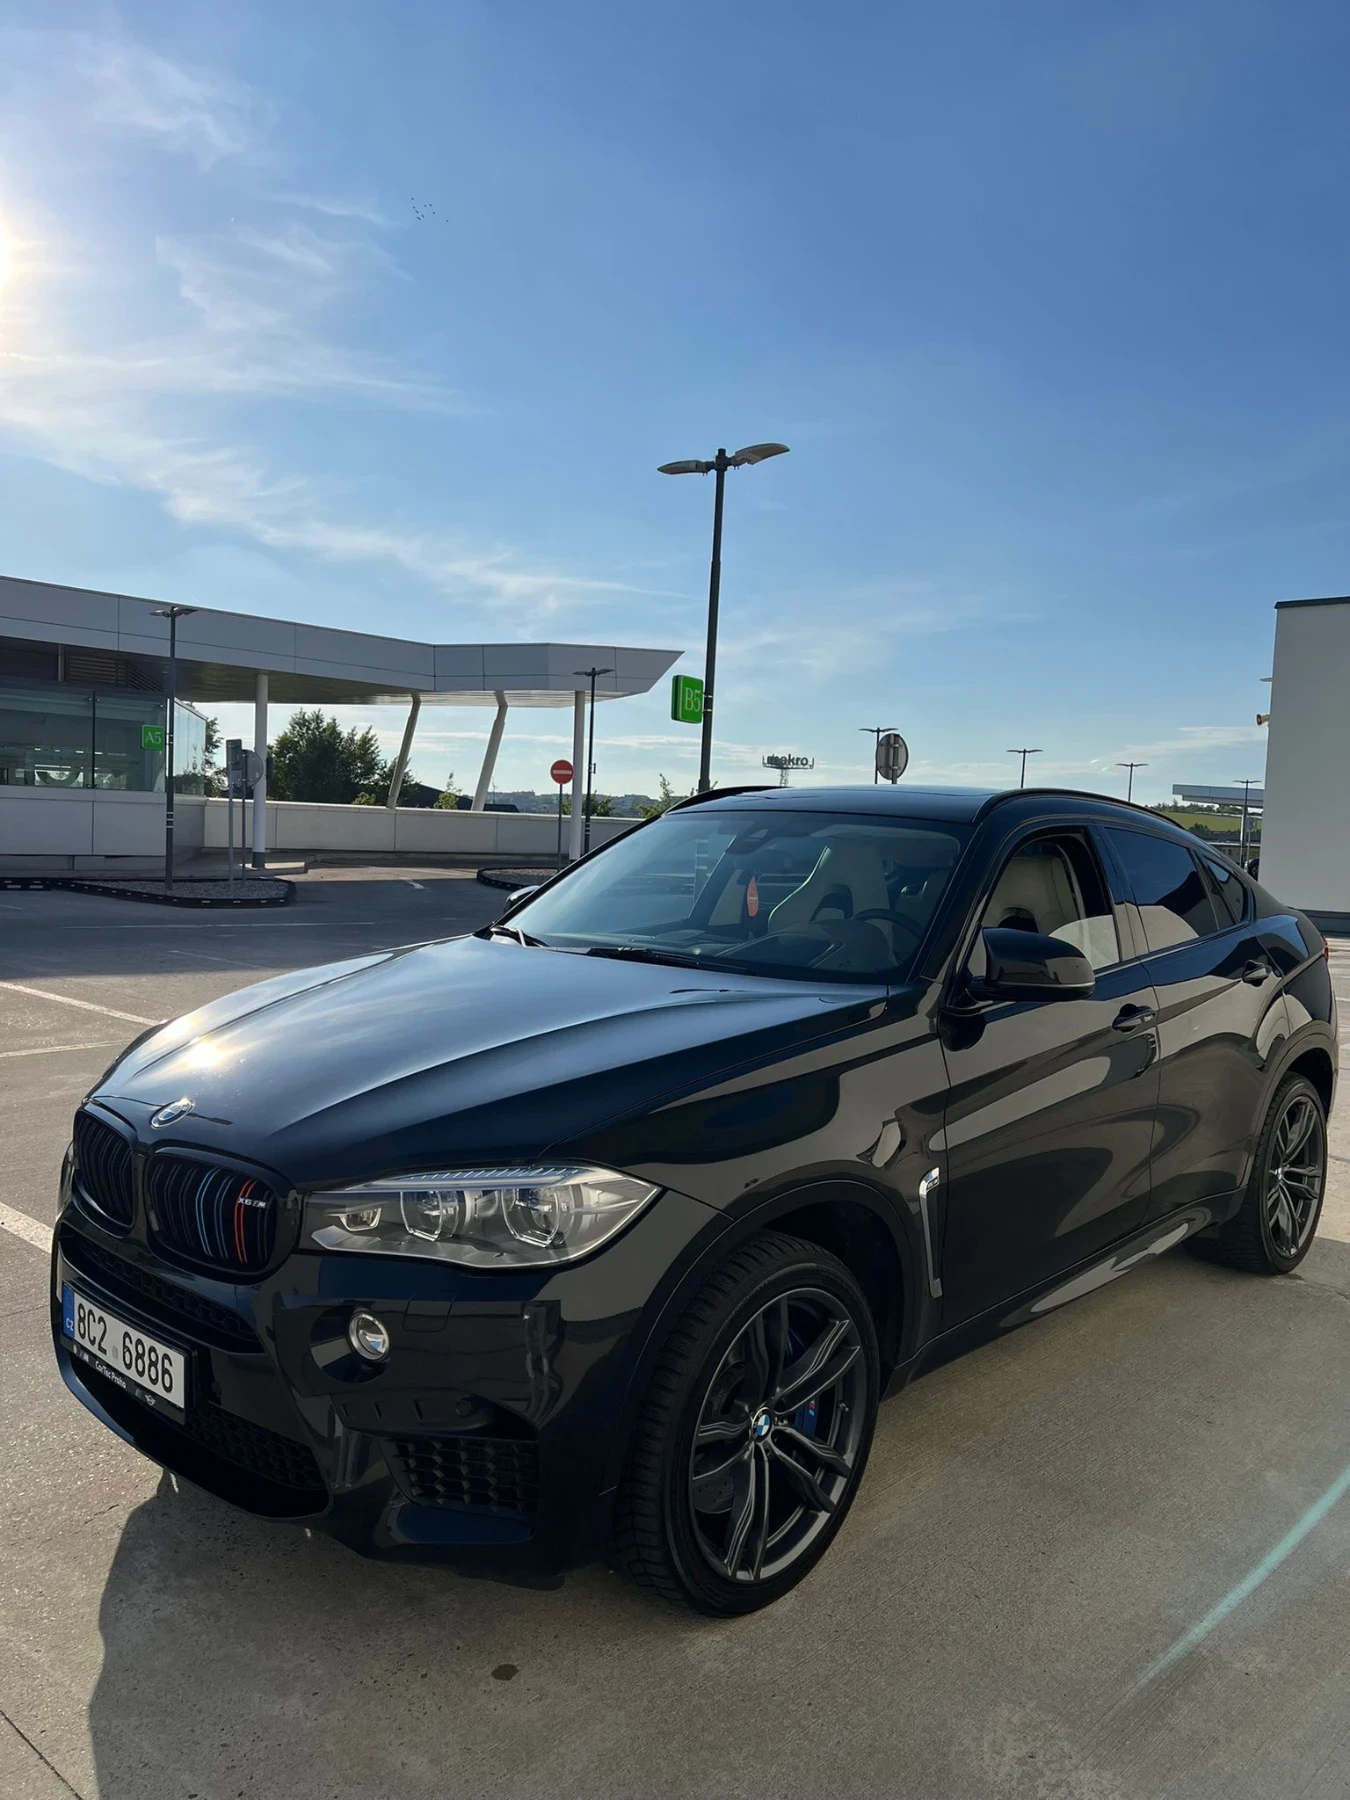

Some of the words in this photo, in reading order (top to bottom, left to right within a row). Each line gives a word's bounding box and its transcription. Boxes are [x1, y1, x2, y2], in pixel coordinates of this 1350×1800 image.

[684, 687, 701, 712] B5
[145, 731, 162, 745] A5
[65, 1317, 74, 1331] CZ
[77, 1303, 107, 1355] 8C2
[122, 1331, 173, 1394] 6886
